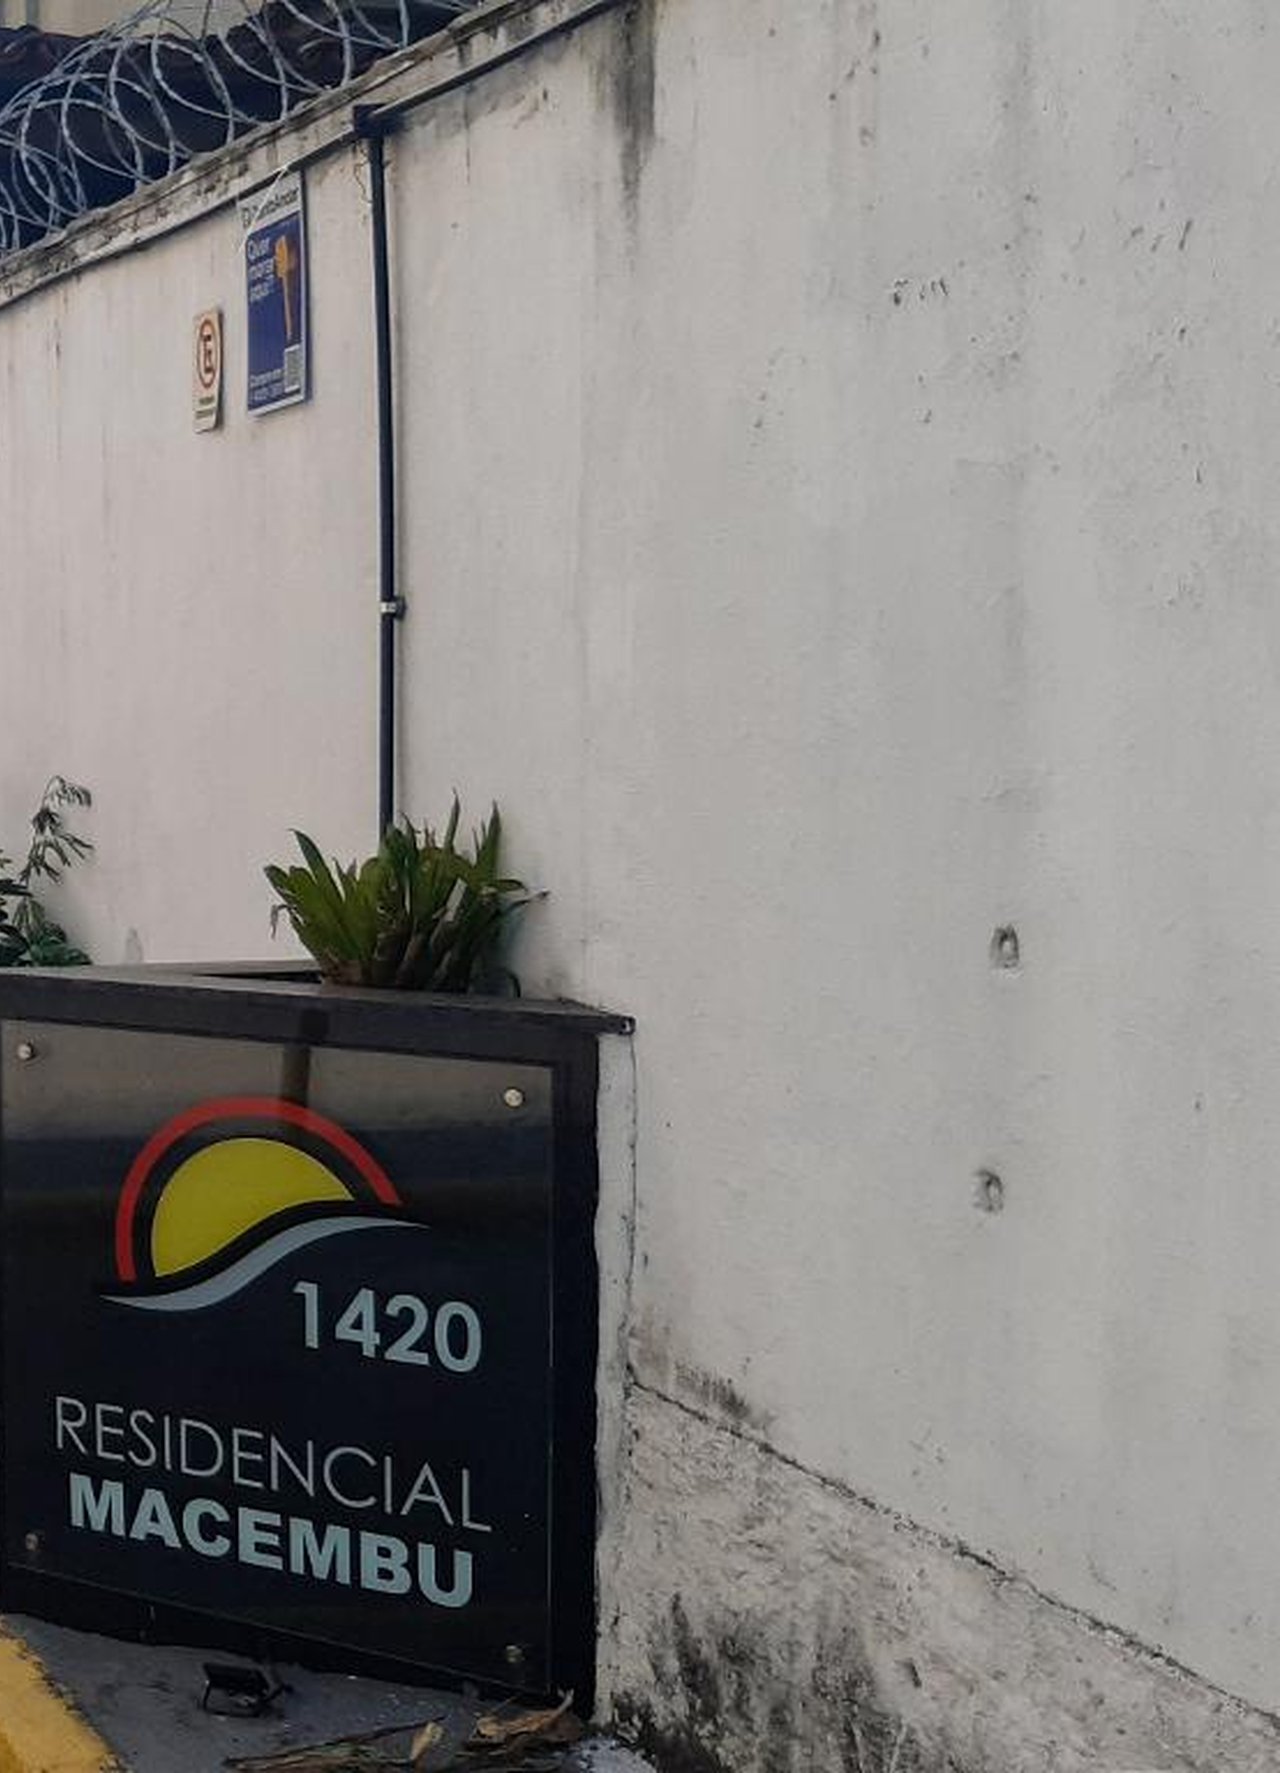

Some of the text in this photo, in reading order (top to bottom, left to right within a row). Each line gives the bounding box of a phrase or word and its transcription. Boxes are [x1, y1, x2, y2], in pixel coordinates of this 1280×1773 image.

[293, 1280, 483, 1372] 1420
[55, 1396, 493, 1532] RESIDENCIAL
[68, 1473, 474, 1608] MACEMBU
